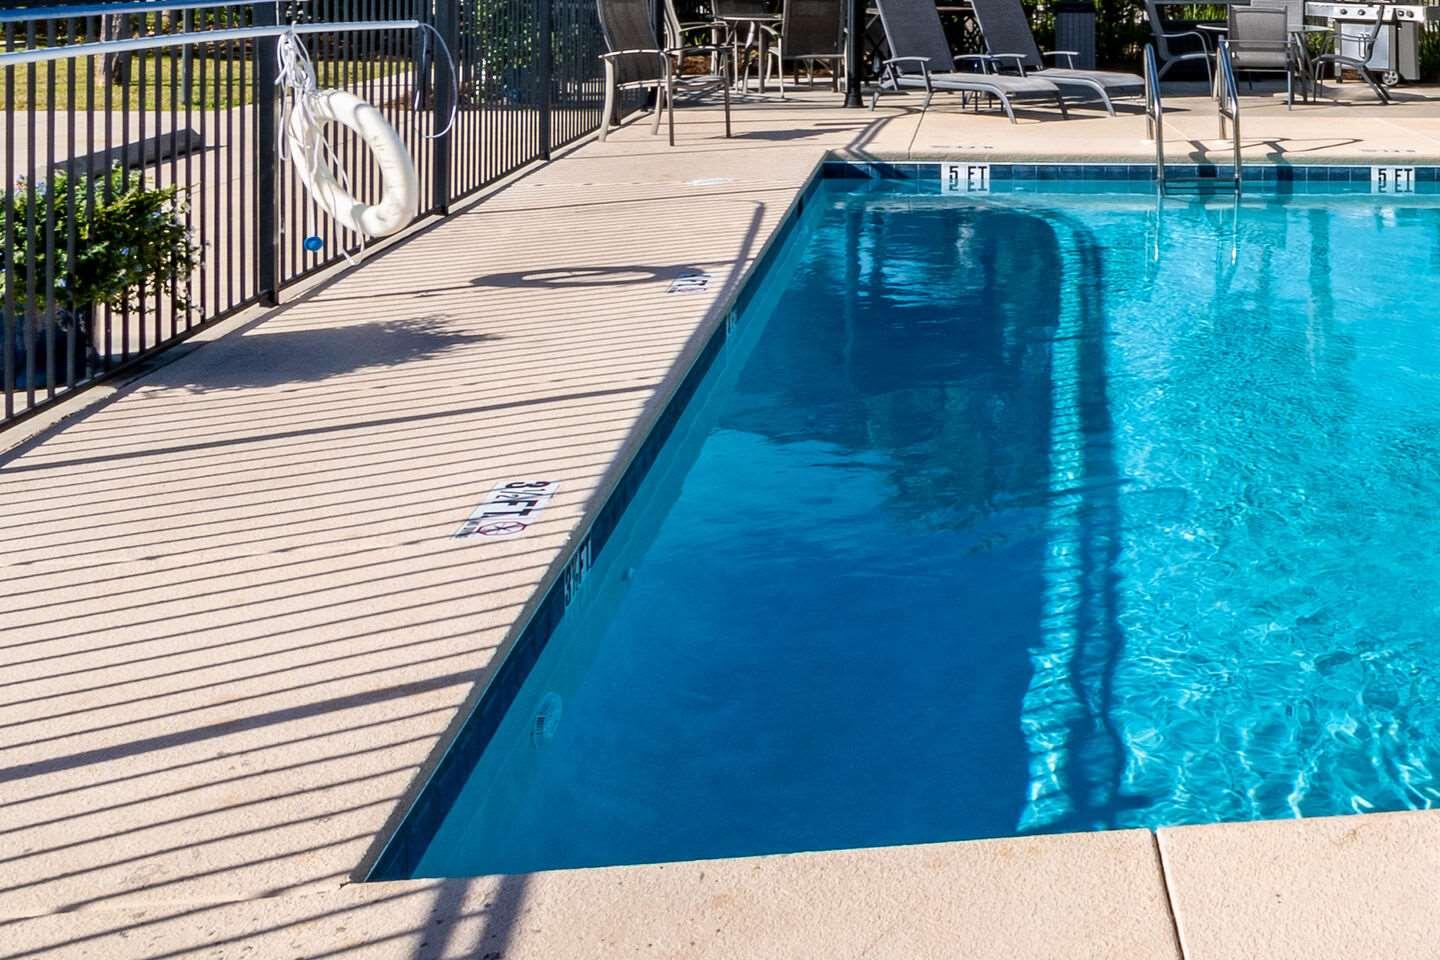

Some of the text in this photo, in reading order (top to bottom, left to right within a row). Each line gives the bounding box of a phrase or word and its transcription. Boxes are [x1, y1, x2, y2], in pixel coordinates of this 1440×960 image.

[949, 166, 988, 180] 5 FT
[1379, 168, 1413, 182] 5 FT
